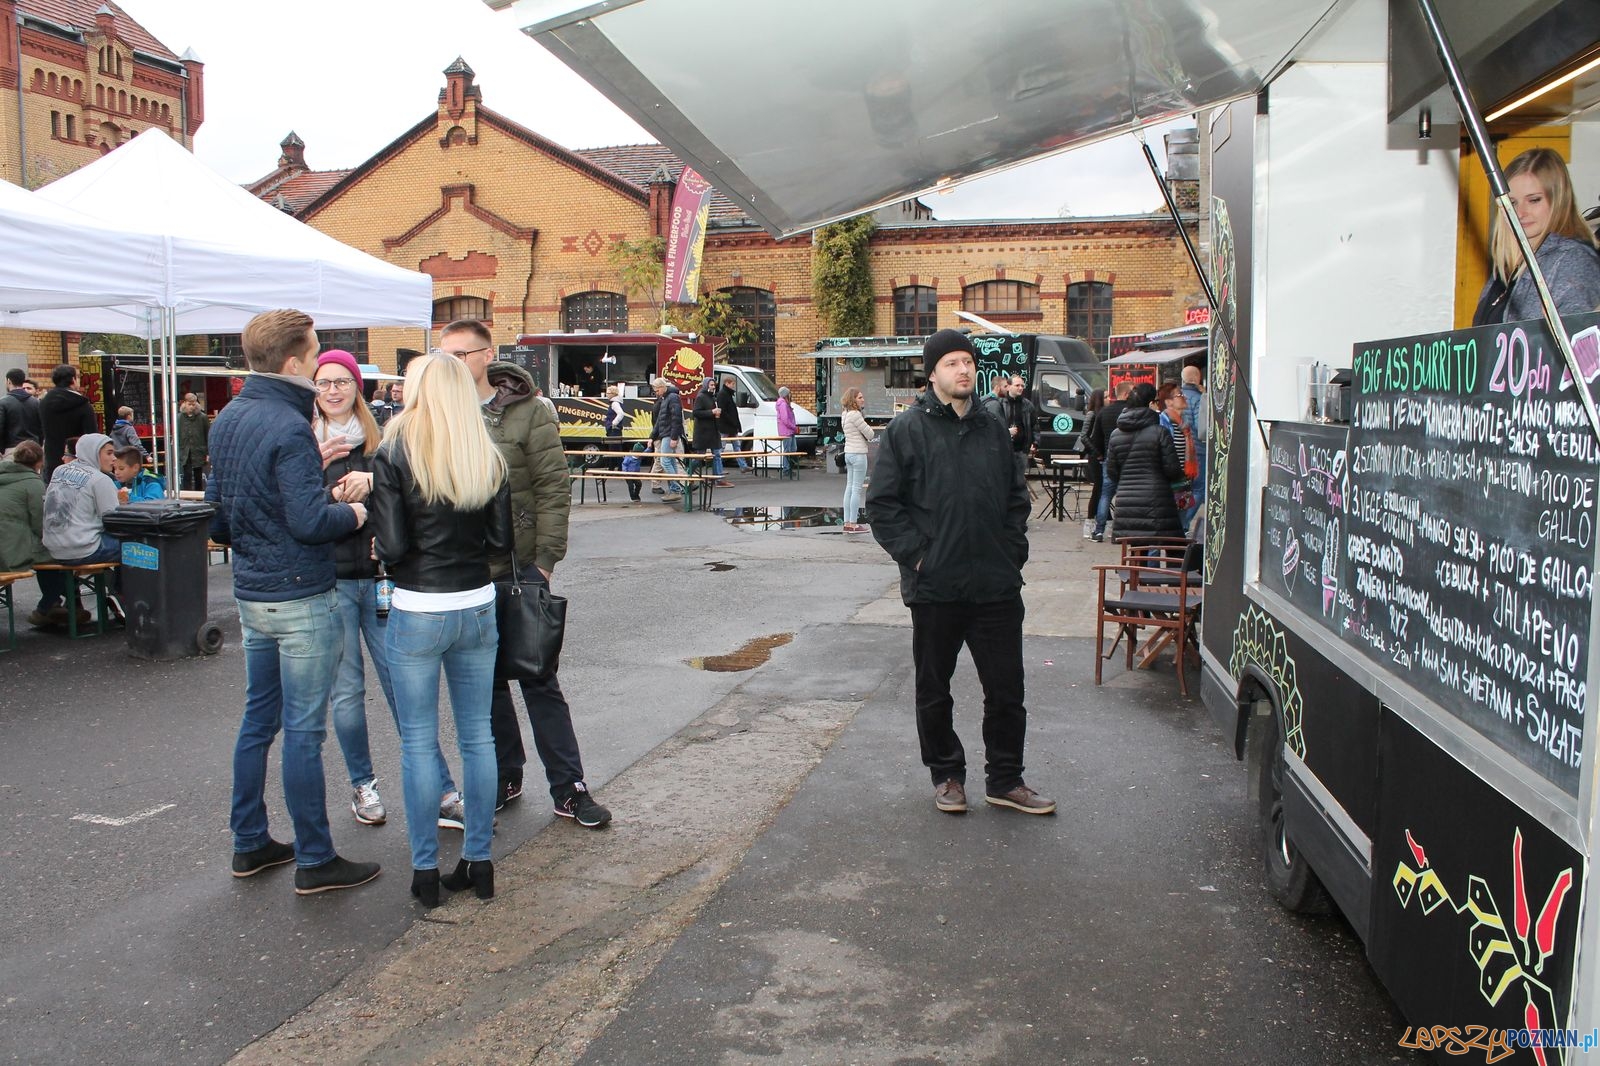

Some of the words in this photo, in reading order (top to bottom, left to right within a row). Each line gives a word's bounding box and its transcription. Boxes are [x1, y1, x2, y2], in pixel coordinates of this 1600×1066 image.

[668, 207, 682, 259] FINGERFOOD
[665, 269, 674, 299] FRYTKI
[1385, 347, 1409, 391] ASS
[1512, 398, 1551, 430] MANGO
[1309, 444, 1332, 475] TACOS
[1508, 427, 1540, 459] SALSA
[1452, 448, 1476, 481] SALSA
[1541, 470, 1569, 504] PICO
[1573, 477, 1595, 509] DE
[1538, 509, 1591, 548] GALLO
[1453, 526, 1479, 562] SALSA
[1489, 543, 1514, 574] PICO
[1516, 551, 1536, 585] DE
[1541, 556, 1587, 599] GALLO
[1493, 581, 1579, 673] JALAPENO
[1476, 624, 1545, 694] KUKURYDZA
